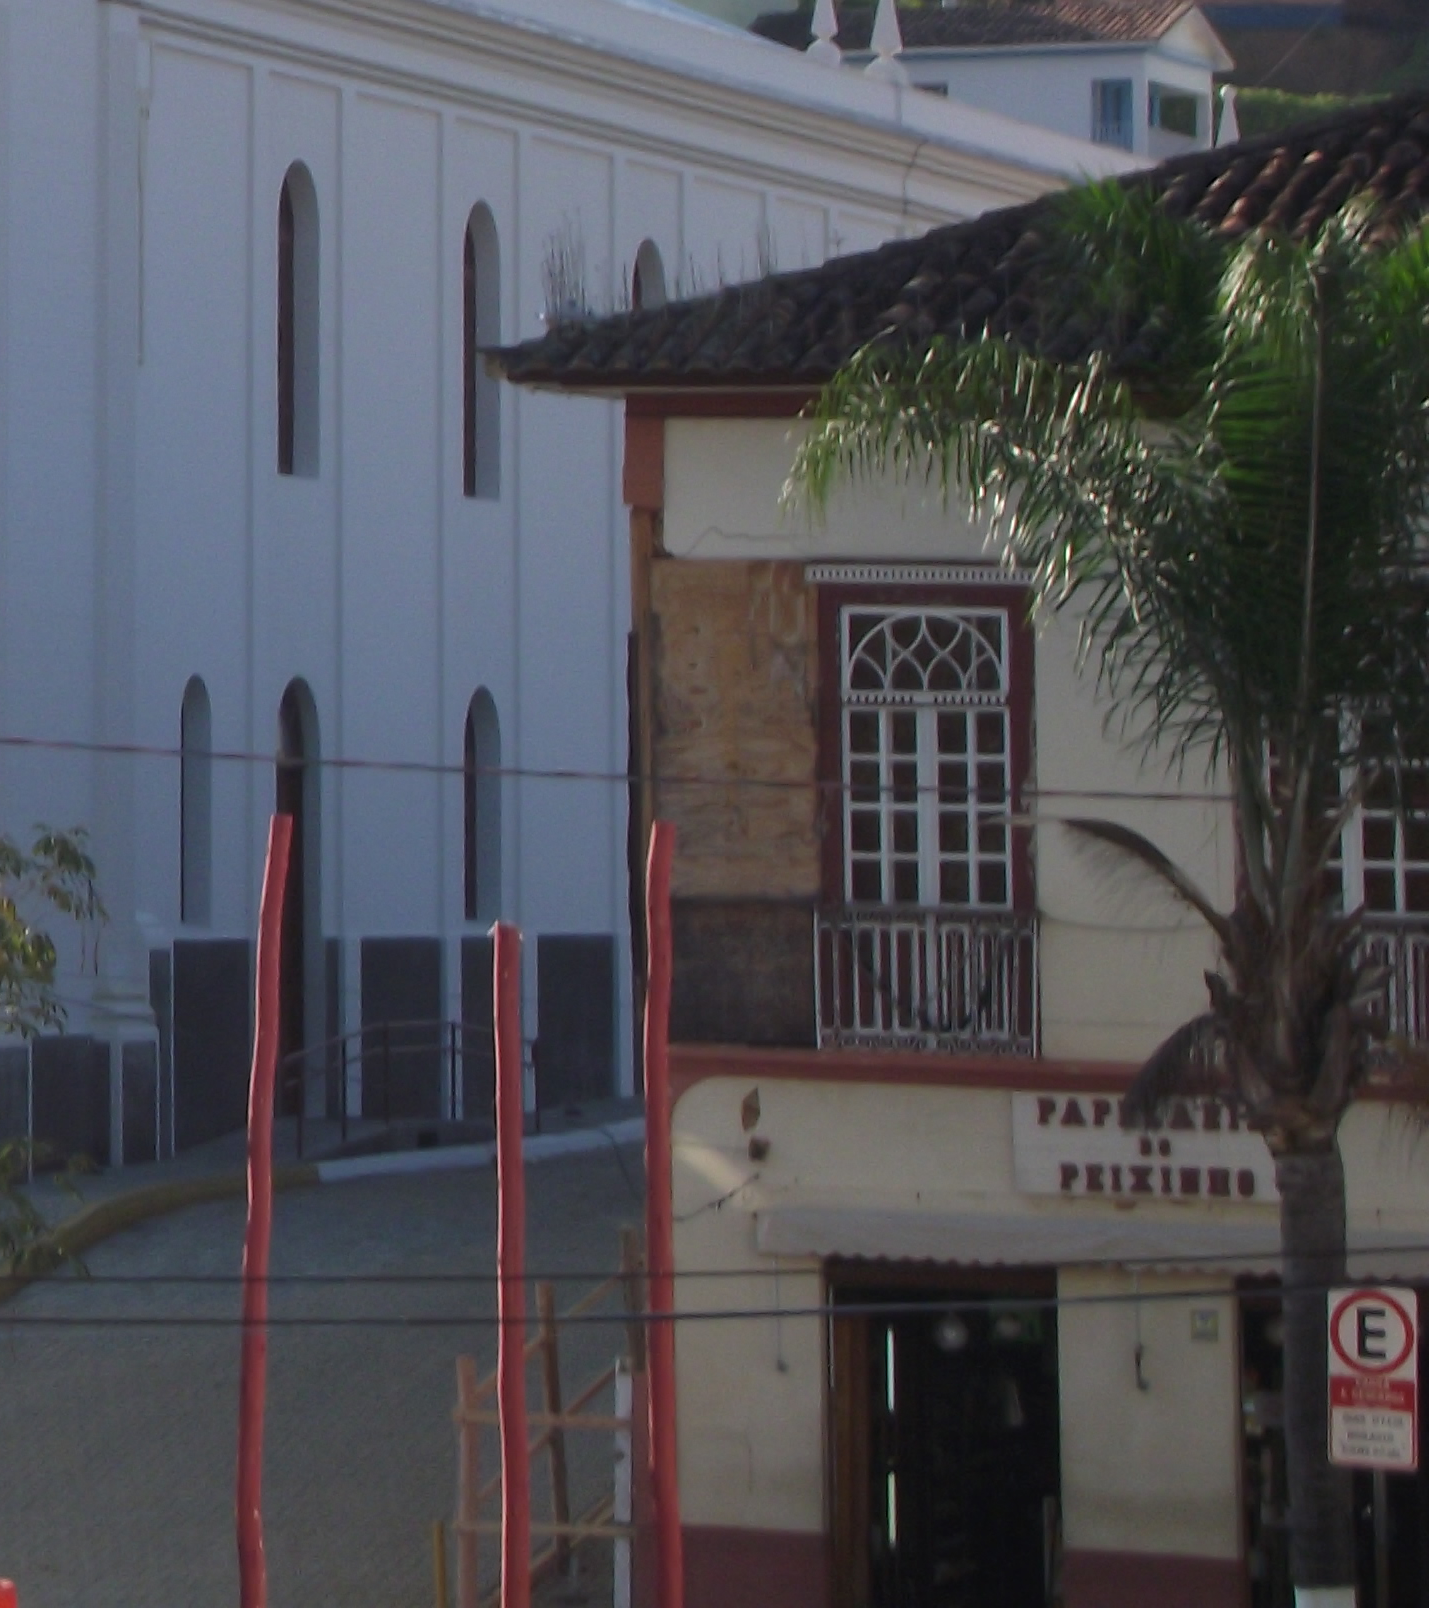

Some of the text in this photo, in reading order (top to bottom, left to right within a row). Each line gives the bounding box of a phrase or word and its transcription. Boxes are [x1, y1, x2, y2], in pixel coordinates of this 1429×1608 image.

[1037, 1097, 1265, 1131] PAPARI
[1060, 1162, 1255, 1197] PEIXINHO
[1356, 1306, 1387, 1360] E
